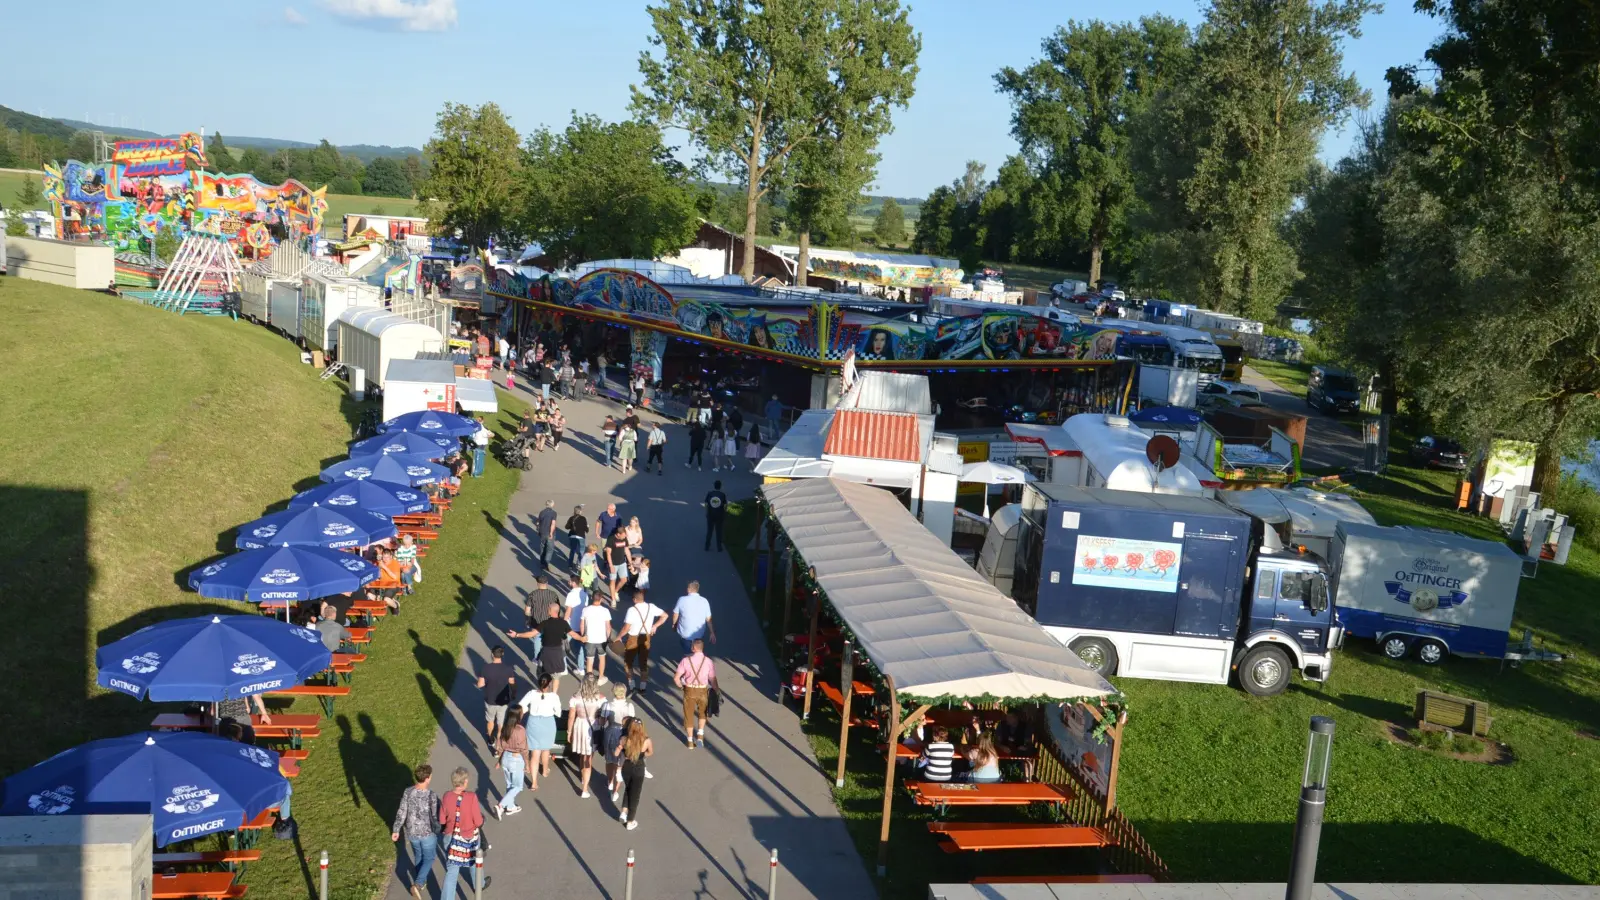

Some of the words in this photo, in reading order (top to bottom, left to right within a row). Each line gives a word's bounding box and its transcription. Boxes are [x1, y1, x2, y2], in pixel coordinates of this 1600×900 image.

[115, 140, 177, 160] BREAK
[127, 153, 186, 174] DANCE
[1395, 570, 1461, 590] OETTINGER
[240, 679, 282, 694] OETTINGER
[166, 788, 212, 804] OETTINGER
[172, 818, 225, 838] OETTINGER
